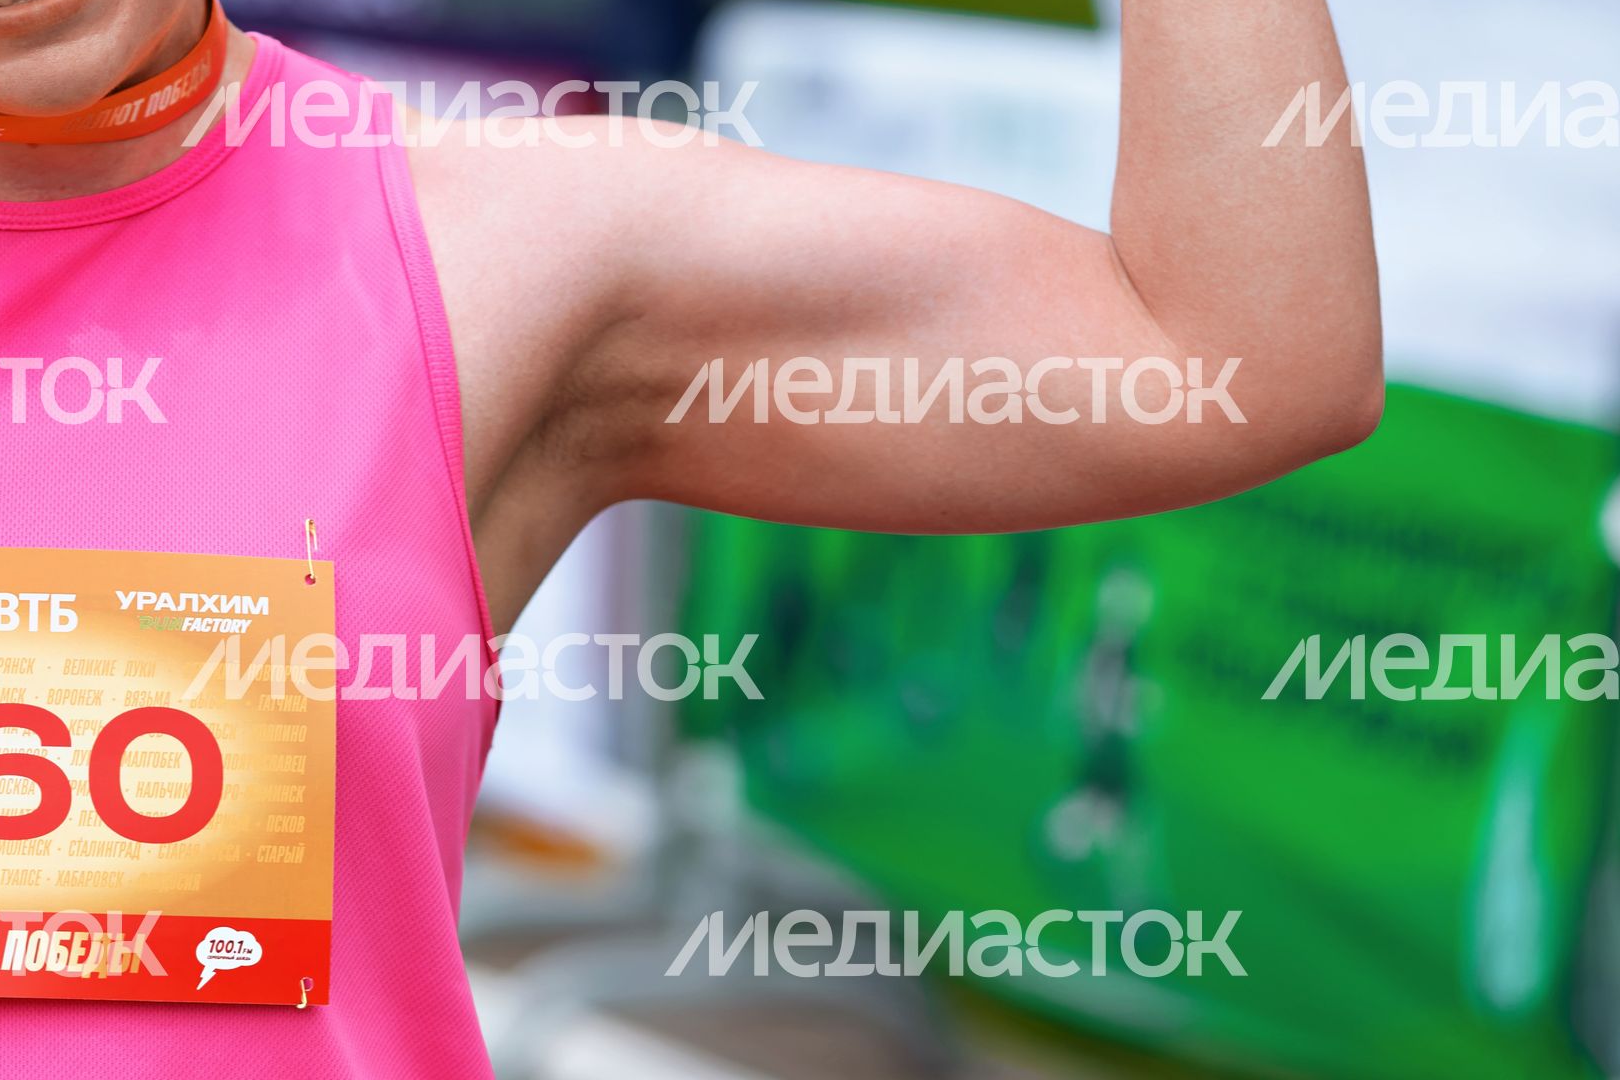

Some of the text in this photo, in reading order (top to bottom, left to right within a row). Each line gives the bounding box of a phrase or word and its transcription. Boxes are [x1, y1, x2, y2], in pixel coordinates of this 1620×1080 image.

[115, 591, 269, 616] УРАЛХИМ
[63, 658, 117, 677] ВЕЛИКИЕ
[123, 660, 157, 679] ЛУКИ
[46, 688, 104, 706] ВОРОНЕЖ
[123, 689, 171, 707] ВЯЗЬМА
[266, 814, 306, 834] ПСКОВ
[67, 838, 141, 861] СТАЛИНГРАД
[256, 842, 307, 865] СТАРЫЙ
[0, 869, 43, 888] ТУАПСЕ
[54, 869, 126, 890] ХАБАРОВСК
[1, 929, 146, 980] ПОБЕДЫ
[209, 939, 244, 954] 100.1
